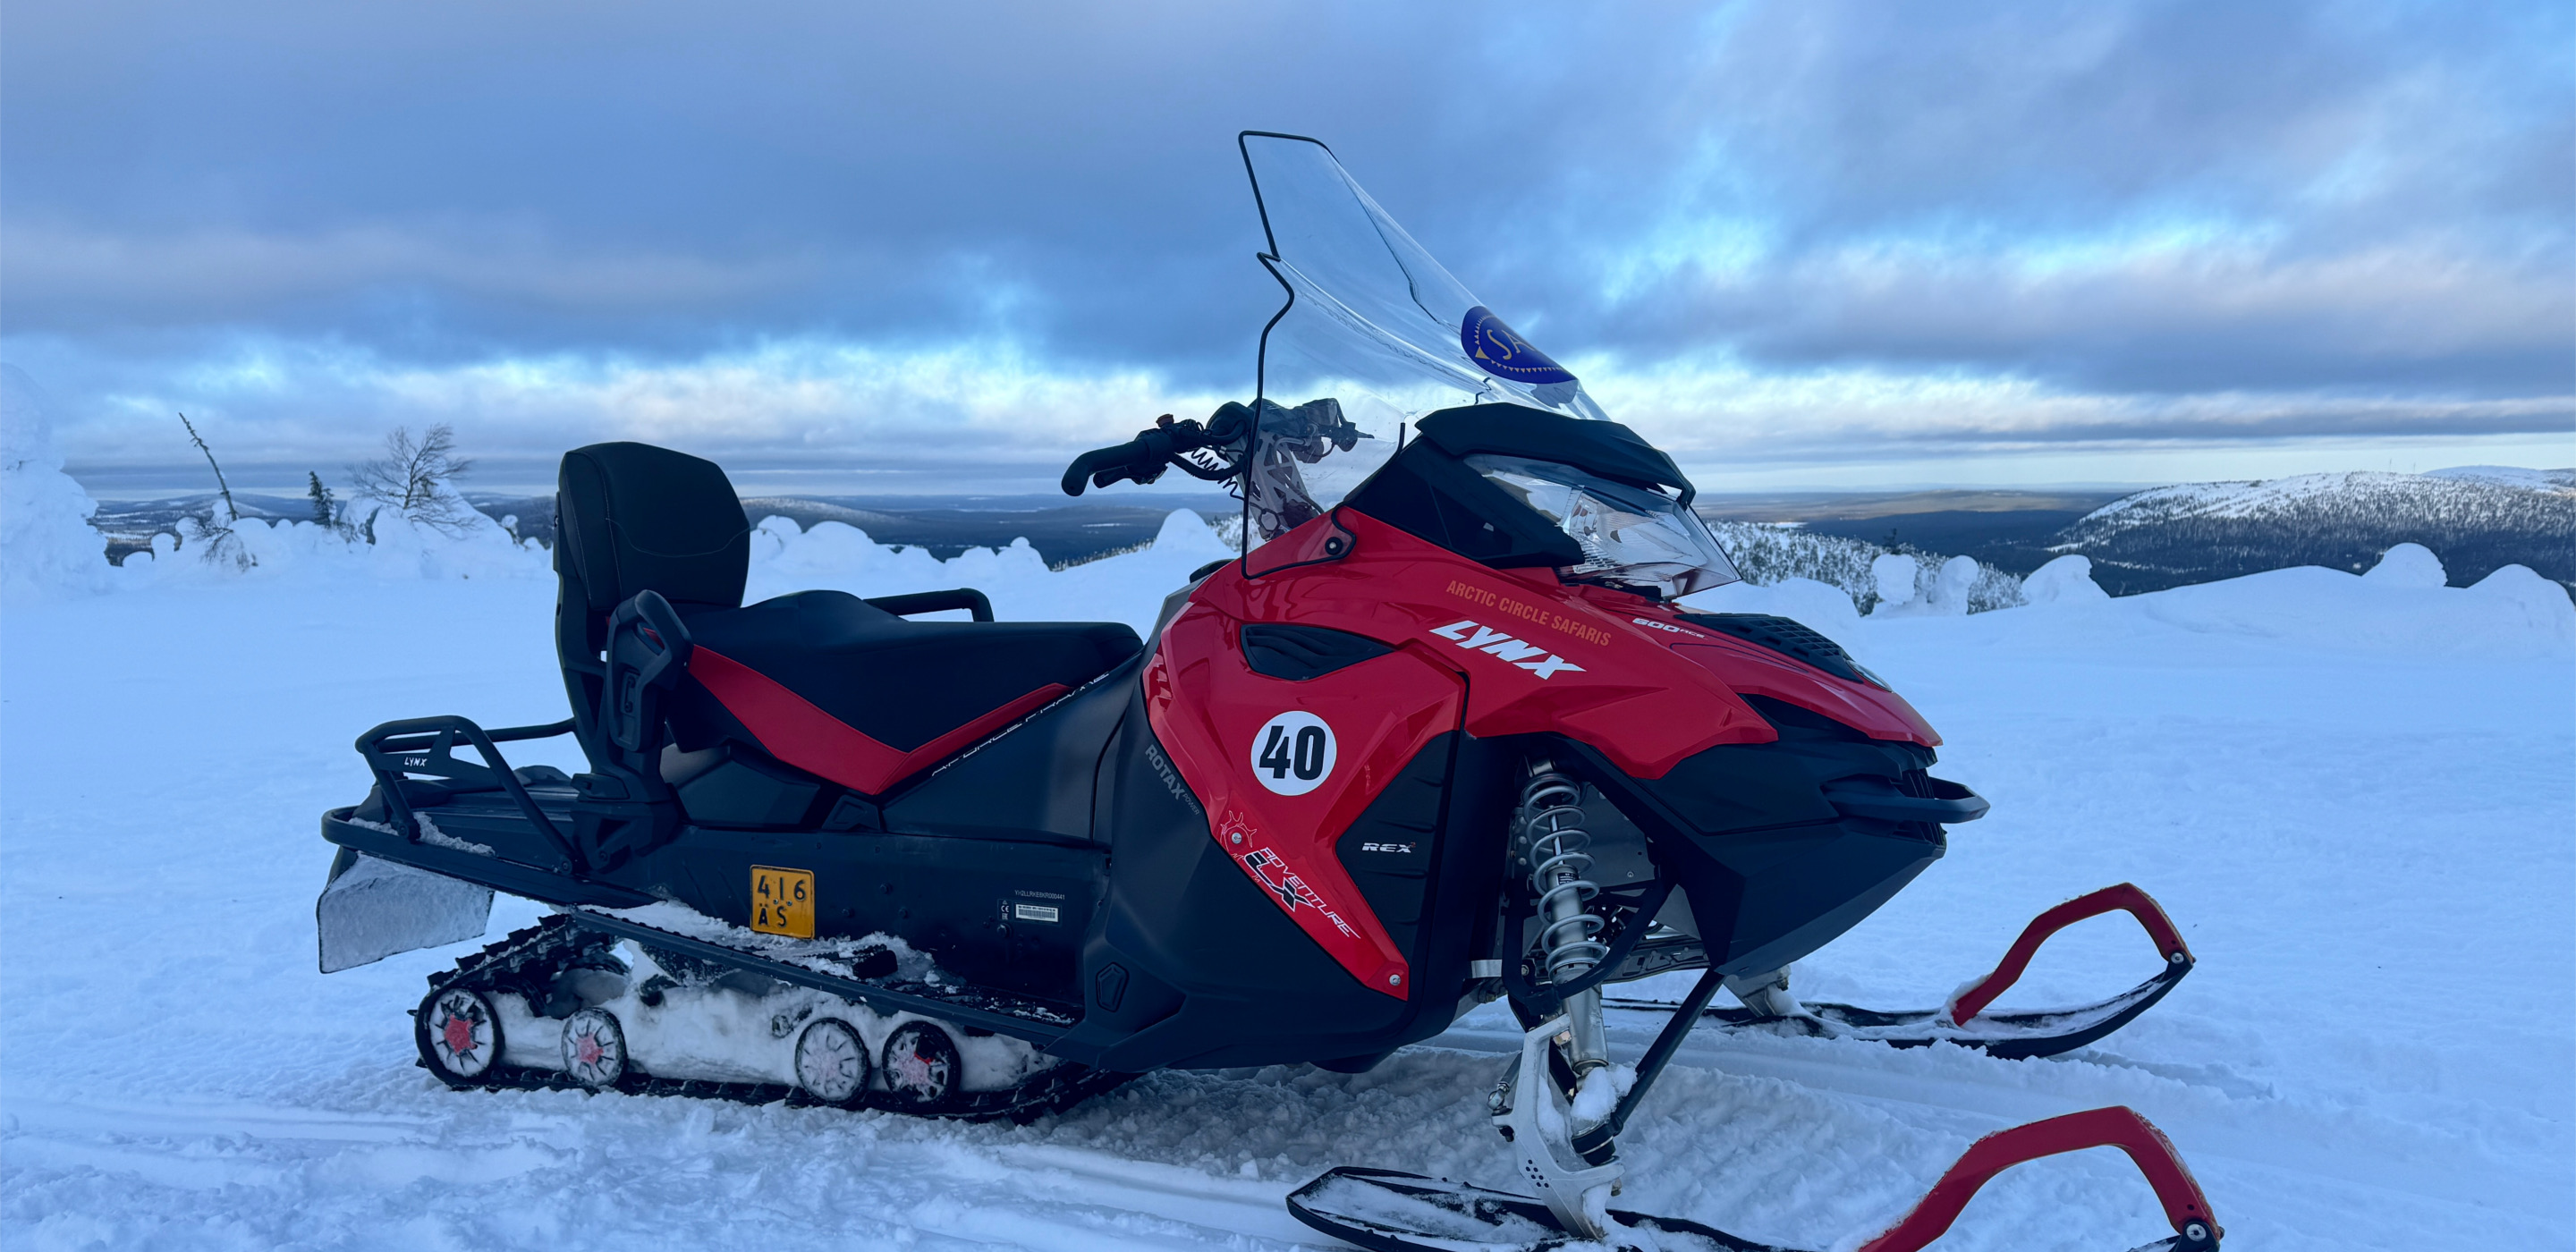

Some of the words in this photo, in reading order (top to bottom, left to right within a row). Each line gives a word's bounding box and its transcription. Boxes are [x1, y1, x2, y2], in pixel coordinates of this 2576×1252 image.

[1446, 580, 1496, 607] ARCTIC
[1498, 597, 1550, 625] CIRCLE
[1551, 615, 1612, 647] SAFARIS
[1632, 618, 1681, 633] 600
[1429, 620, 1588, 680] LYNX
[404, 757, 428, 767] LYNX
[1145, 744, 1185, 800] ROTAX
[1182, 793, 1200, 815] POWER
[1259, 725, 1326, 781] 40
[758, 875, 806, 901] 416
[1243, 850, 1316, 912] LX
[1260, 847, 1361, 939] ADVENTURE
[758, 903, 787, 927] ÄS
